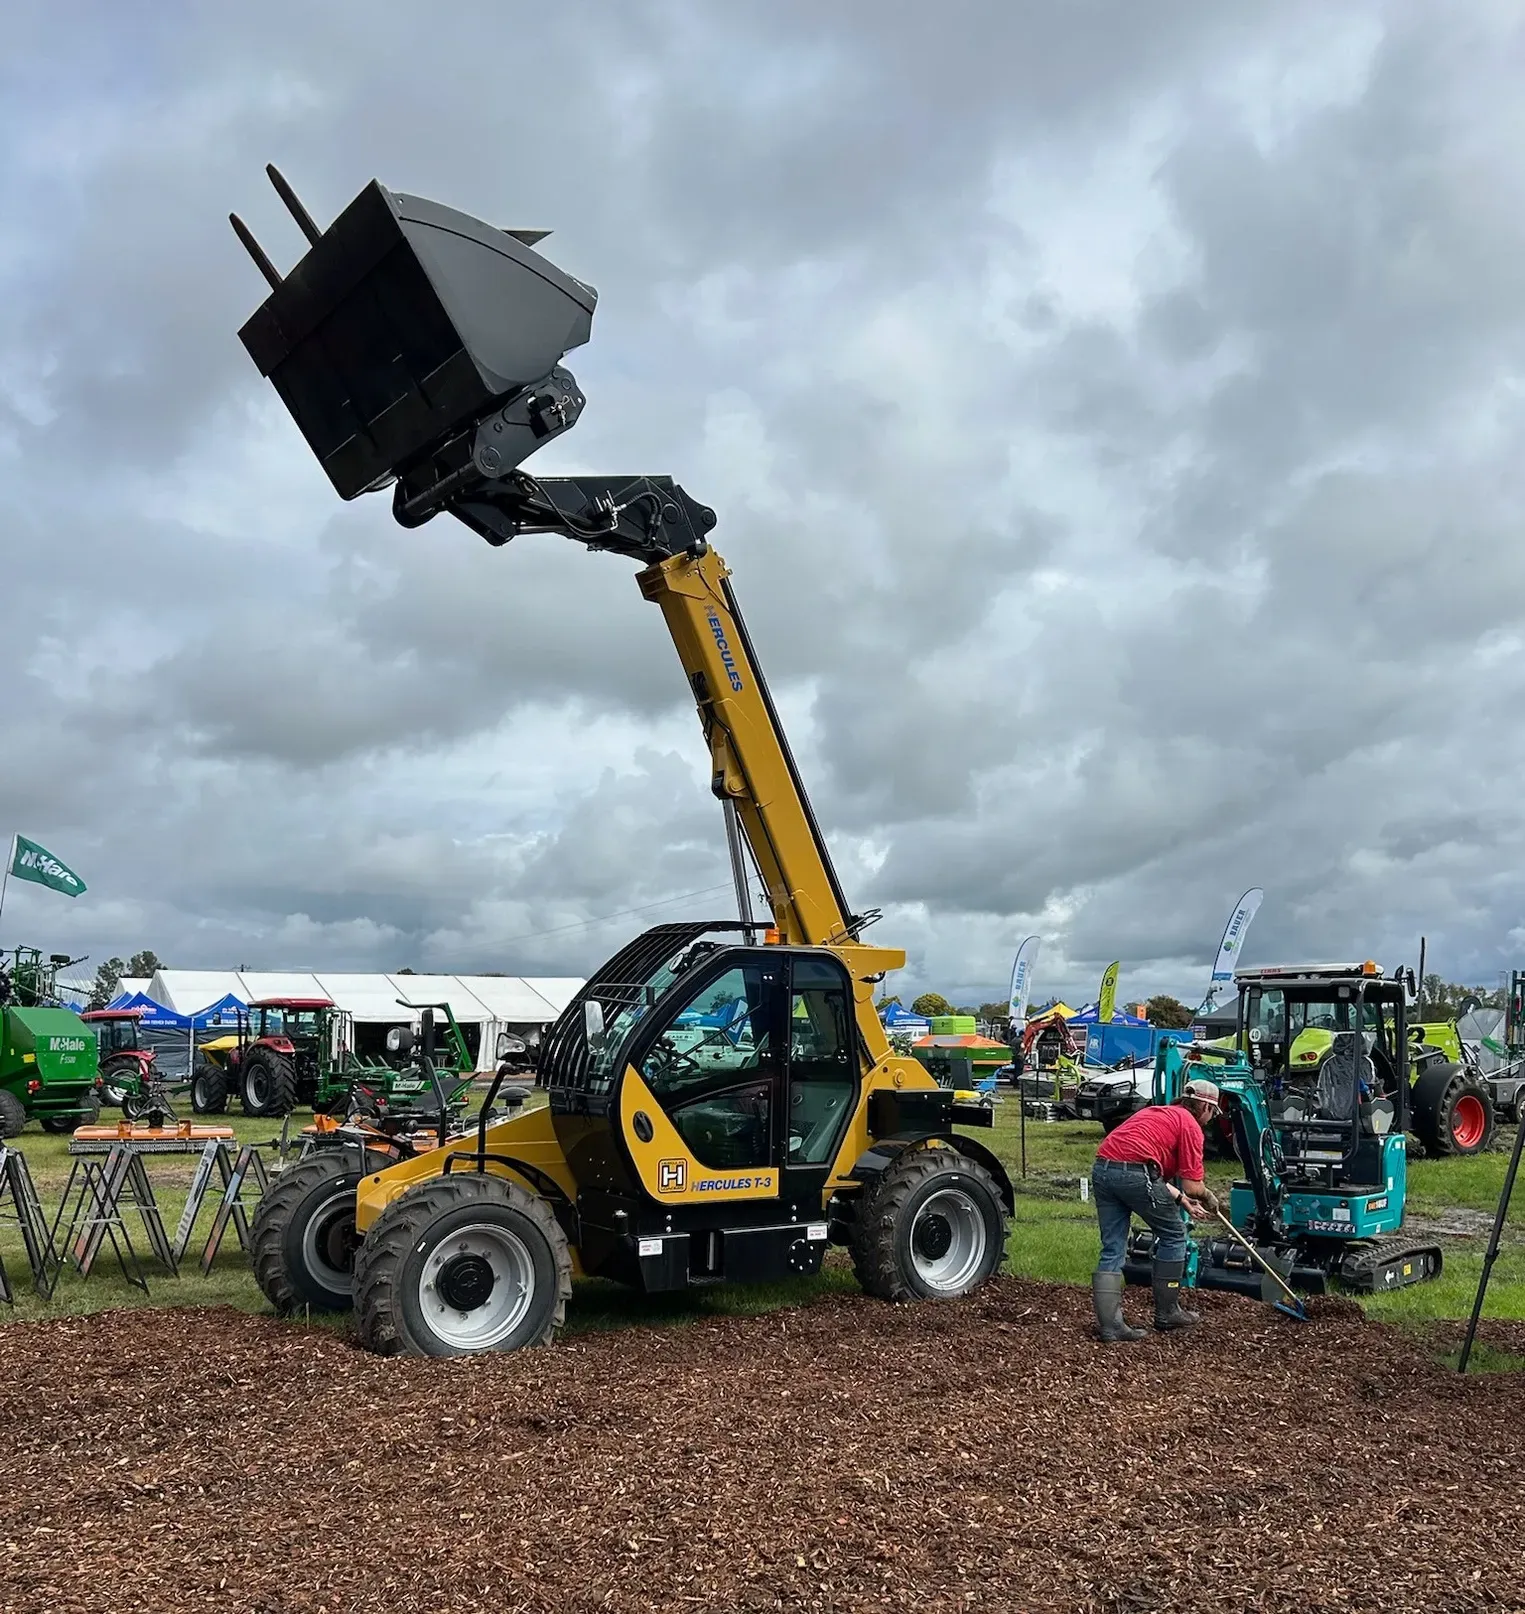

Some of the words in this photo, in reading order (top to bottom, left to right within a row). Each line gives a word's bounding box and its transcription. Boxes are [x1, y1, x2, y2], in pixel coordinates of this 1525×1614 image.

[703, 604, 743, 692] HERCULES
[1229, 908, 1246, 937] BAUER
[1015, 961, 1027, 990] BAUER
[50, 1037, 86, 1051] McHale
[1251, 1030, 1260, 1040] 40
[691, 1178, 752, 1192] HERCULES
[754, 1177, 771, 1188] T-3
